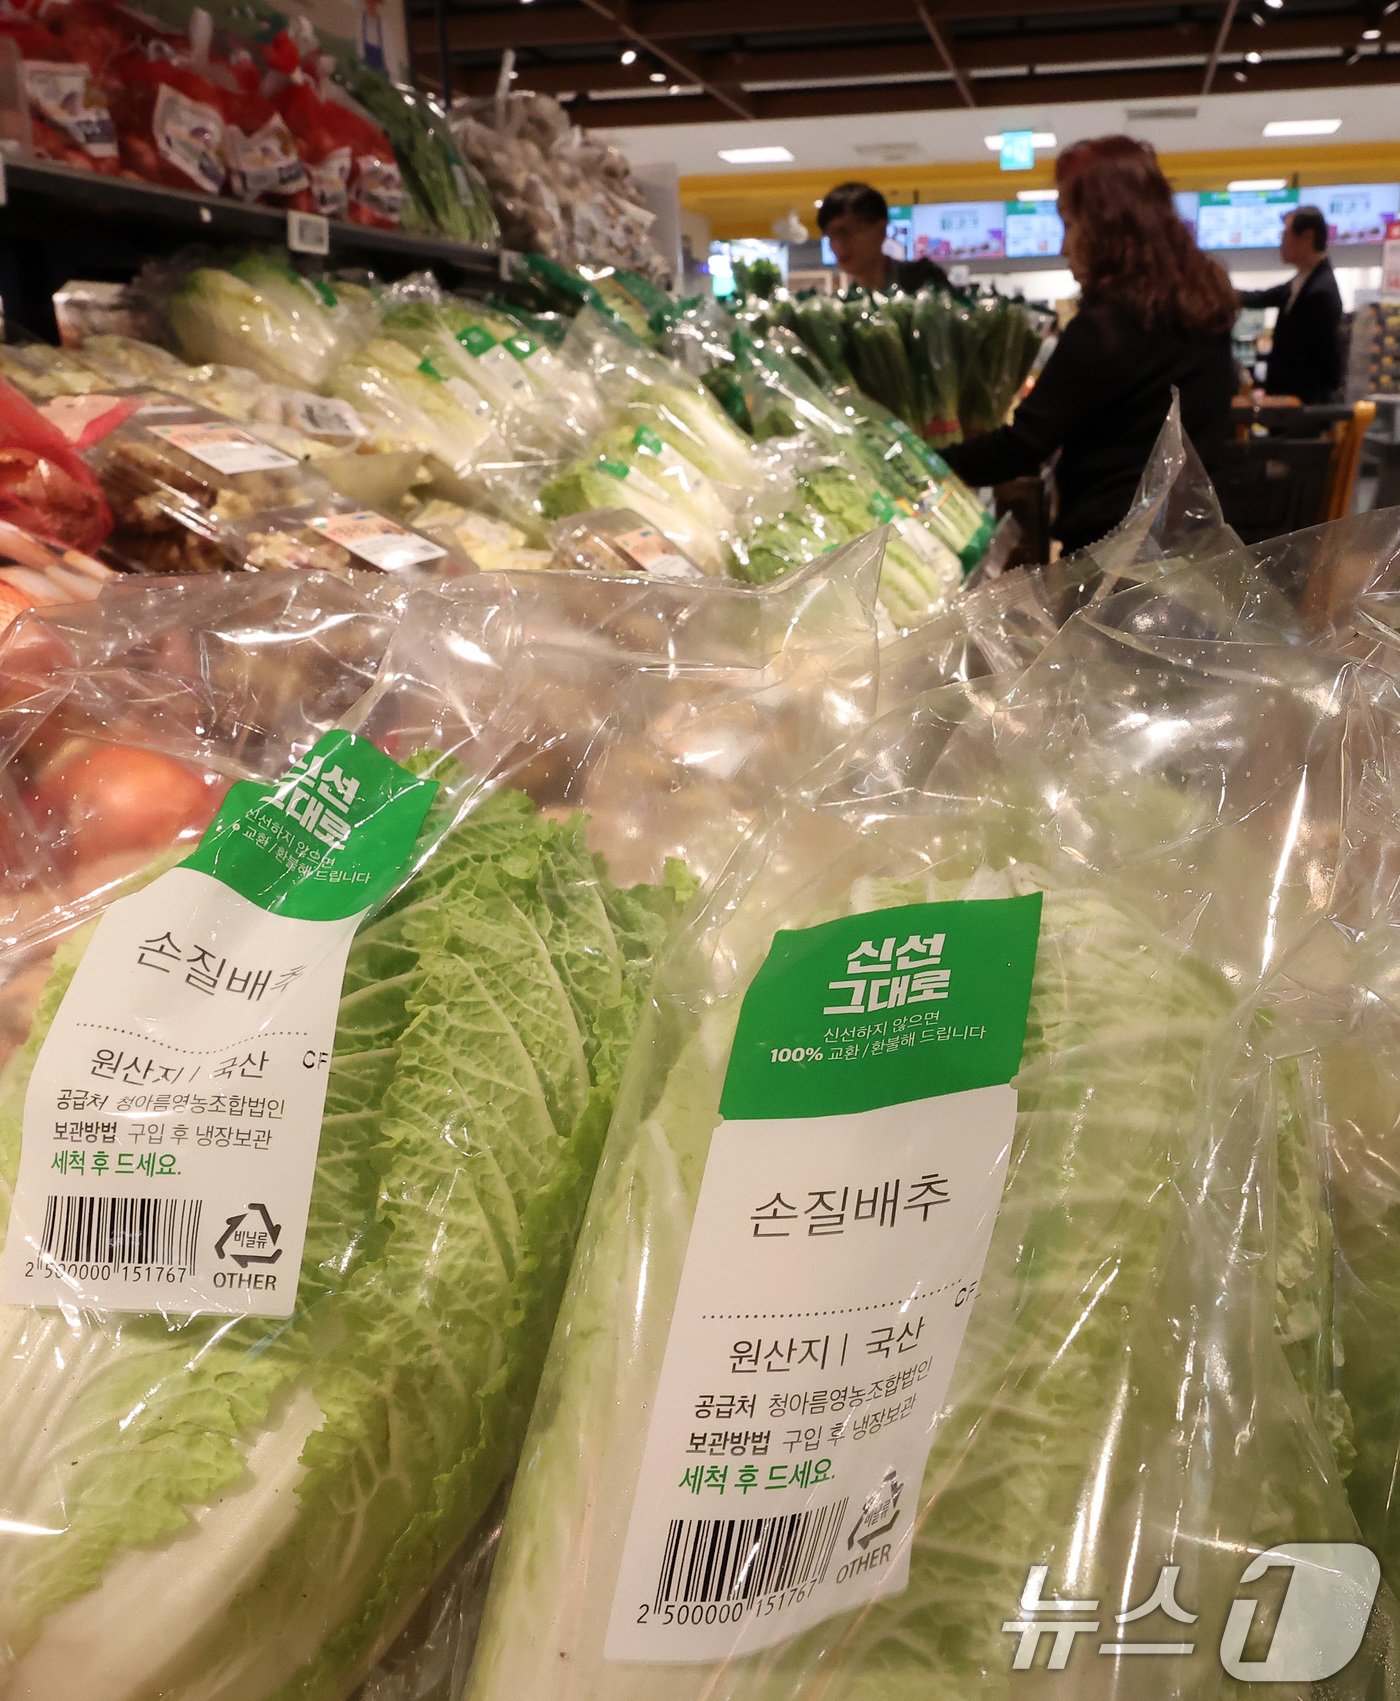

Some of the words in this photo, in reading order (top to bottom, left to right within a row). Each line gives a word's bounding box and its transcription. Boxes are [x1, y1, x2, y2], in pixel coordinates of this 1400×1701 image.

[314, 869, 372, 884] 드립니다
[846, 933, 946, 974] 신선
[823, 969, 951, 1015] 그대로
[770, 1048, 824, 1063] 100%
[919, 1024, 986, 1043] 드립니다
[823, 1021, 888, 1043] 신선하지
[893, 1010, 940, 1034] 않으면
[56, 1089, 109, 1112] 공급처
[116, 1093, 286, 1120] 청아름영농조합법인
[53, 1121, 118, 1144] 보관방법
[128, 1123, 166, 1145] 구입
[170, 1124, 190, 1146] 후
[196, 1126, 273, 1151] 냉장보관
[51, 1150, 86, 1176] 세척
[91, 1151, 110, 1176] 후
[115, 1152, 182, 1178] 드세요.
[750, 1173, 951, 1238] 손질배추
[233, 1230, 268, 1249] 비닐류
[213, 1272, 278, 1291] OTHER
[865, 1316, 926, 1359] 국산
[694, 1394, 757, 1419] 공급처
[768, 1356, 933, 1418] 청아름영농조합법인
[685, 1430, 771, 1457] 보관방법
[782, 1425, 822, 1454] 구입
[827, 1421, 846, 1447] 후
[853, 1393, 917, 1441] 냉장보관
[678, 1464, 729, 1495] 세척
[734, 1464, 759, 1495] 후
[764, 1458, 836, 1490] 드세요.
[836, 1544, 891, 1585] OTHER
[662, 1603, 743, 1625] 500000
